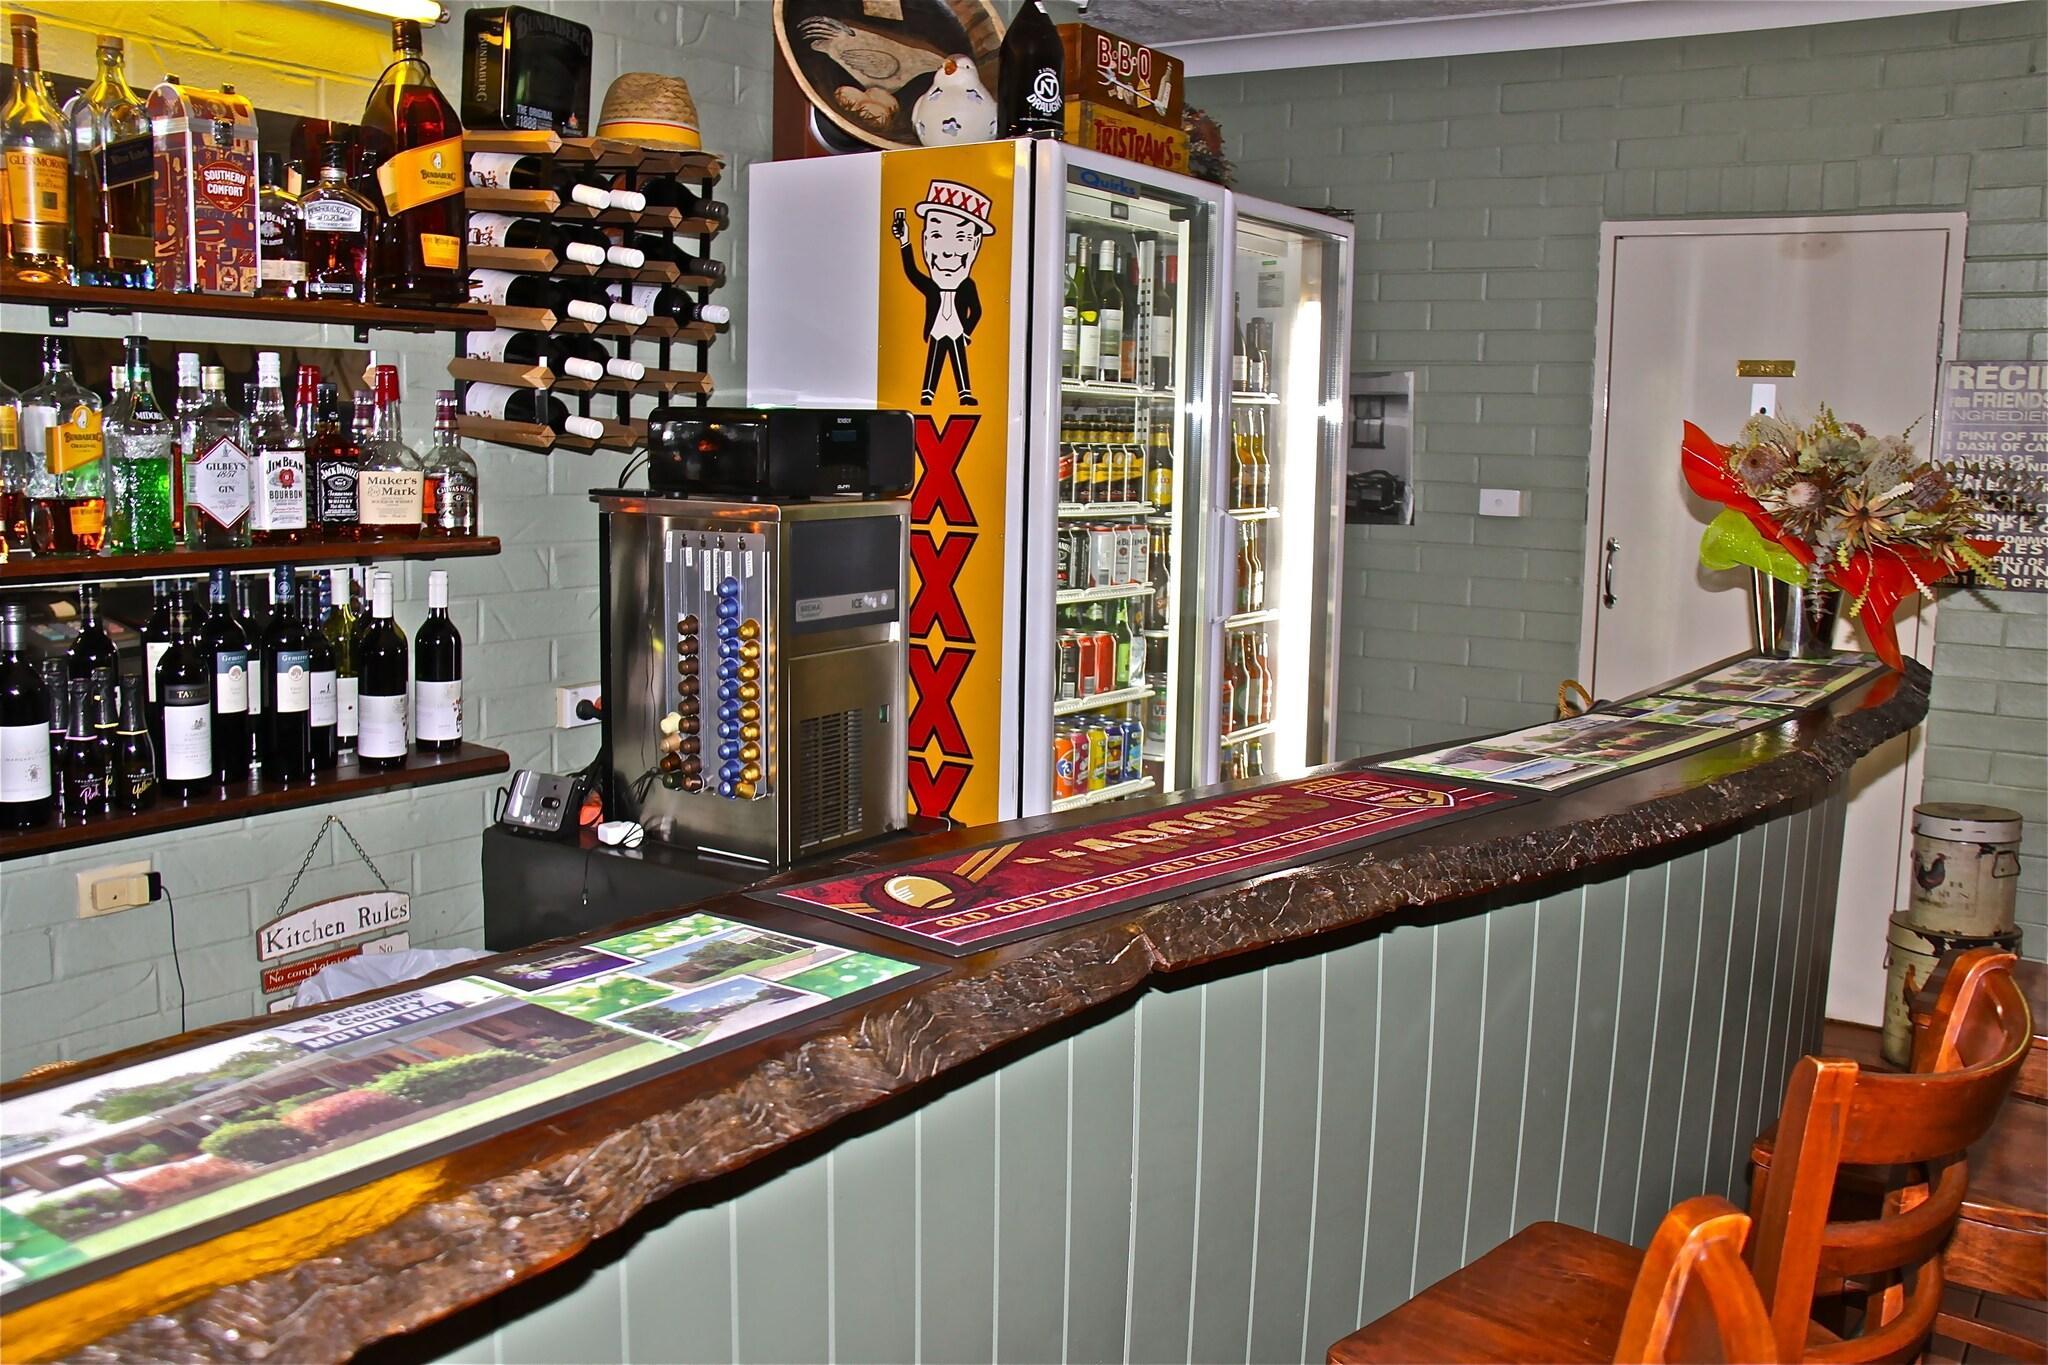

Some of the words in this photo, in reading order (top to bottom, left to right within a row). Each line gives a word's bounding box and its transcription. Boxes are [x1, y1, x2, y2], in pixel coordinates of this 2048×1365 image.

[204, 170, 246, 185] SOUTHERN
[1080, 170, 1136, 194] Quirks
[207, 184, 244, 197] COMFORT
[933, 186, 987, 220] XXXX
[135, 411, 163, 421] MIDORI
[1959, 431, 1997, 440] PINT
[2000, 432, 2027, 441] OF
[1957, 442, 1996, 451] DASH
[2000, 443, 2021, 451] OF
[2025, 443, 2048, 452] CA
[2009, 455, 2034, 463] OF
[206, 462, 246, 471] GILBEY'S
[266, 459, 281, 475] JIM
[283, 456, 304, 473] BEAM
[367, 476, 417, 485] Maker's
[218, 485, 235, 493] GIN
[382, 486, 416, 496] Mark
[269, 490, 303, 500] BOURBON
[2028, 556, 2045, 566] OF
[2011, 578, 2031, 587] OF
[851, 598, 863, 609] ICE
[267, 919, 345, 953] Kitchen
[358, 900, 408, 929] Rules
[378, 944, 393, 953] No
[269, 971, 284, 984] No
[287, 956, 353, 979] complain
[316, 992, 423, 1023] Barcaldine
[338, 1000, 426, 1026] Country
[303, 1018, 401, 1049] MOTOR
[401, 1002, 455, 1021] INN
